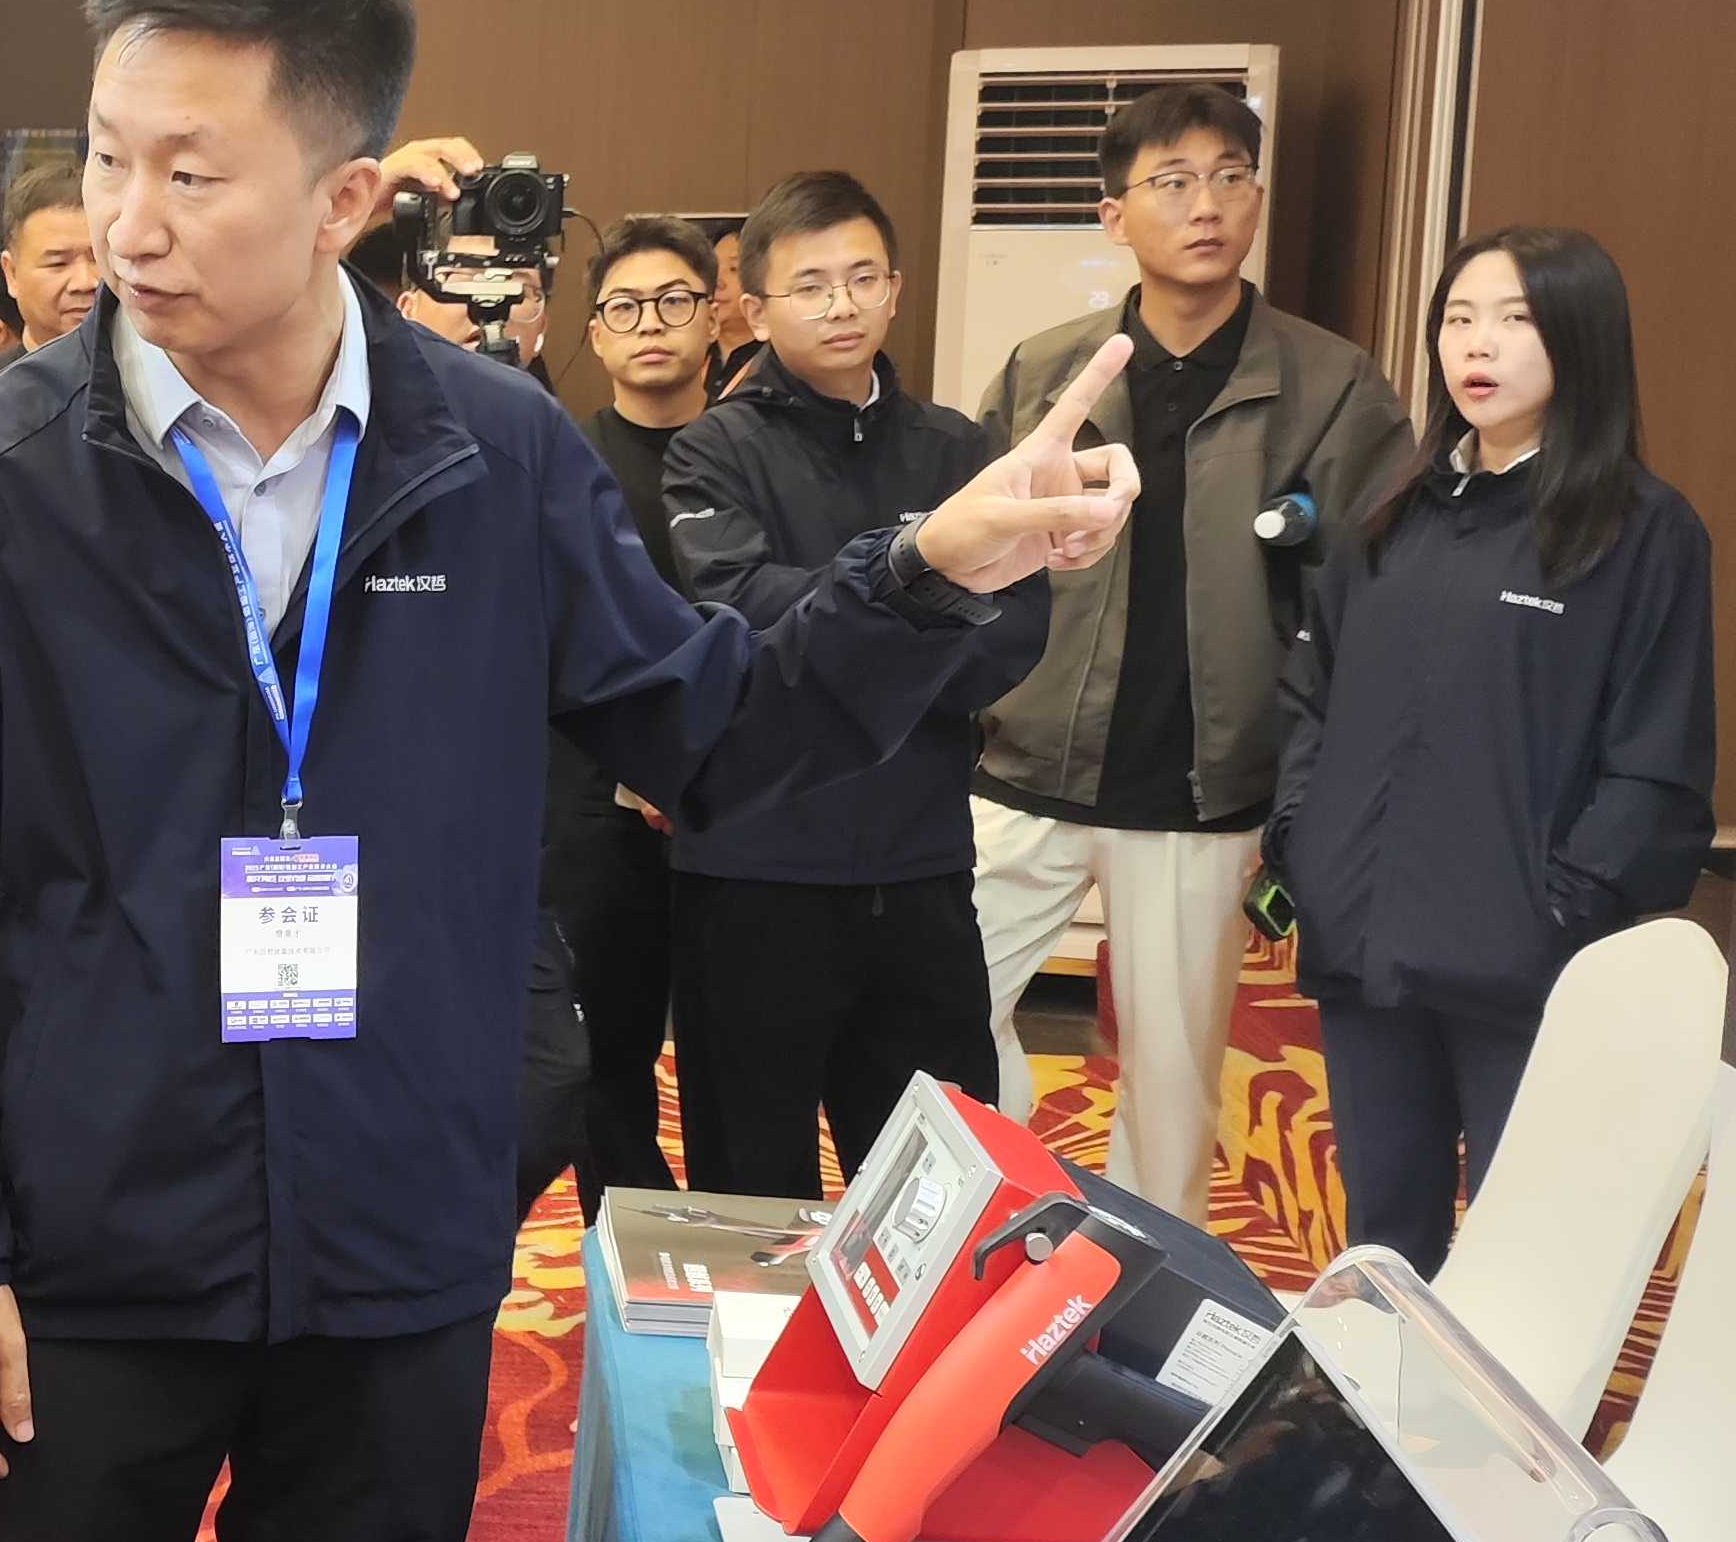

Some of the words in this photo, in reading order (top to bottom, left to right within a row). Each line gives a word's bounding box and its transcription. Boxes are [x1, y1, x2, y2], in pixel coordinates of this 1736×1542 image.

[258, 906, 319, 925] 参会证
[1019, 1294, 1093, 1366] Haztek
